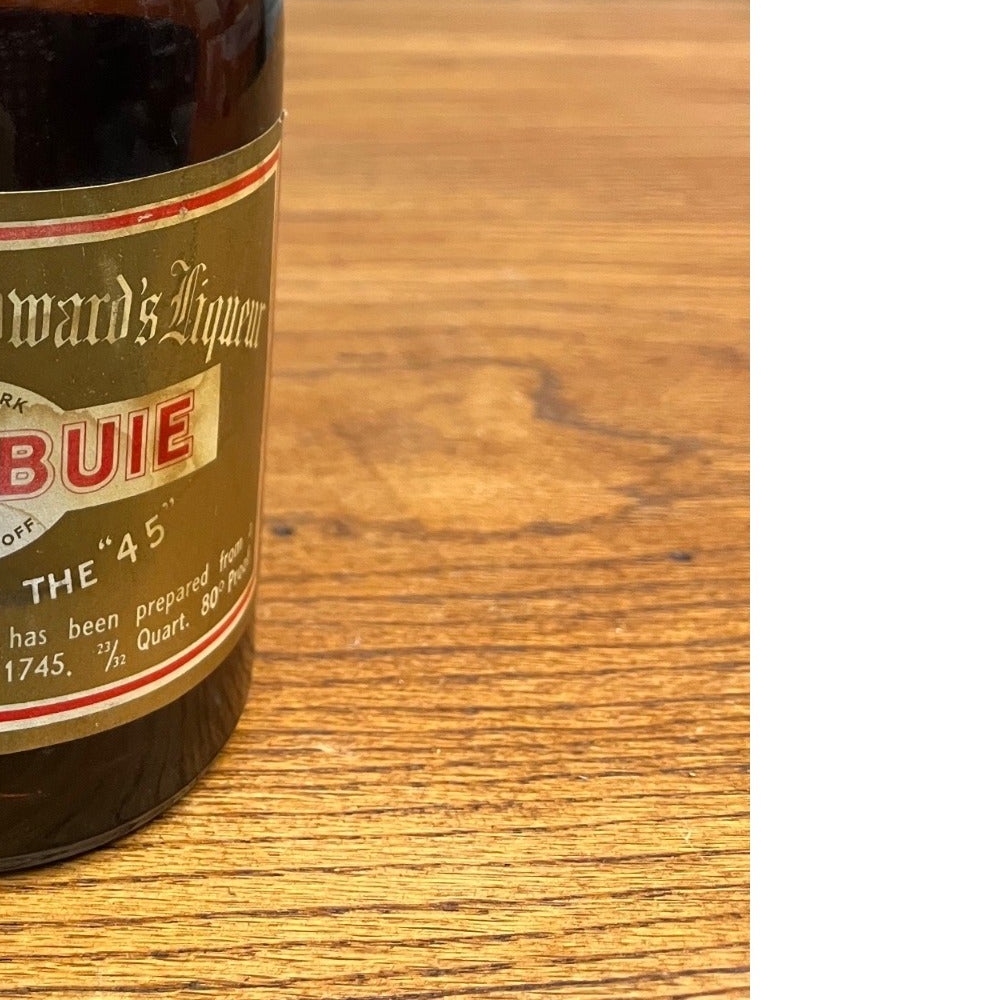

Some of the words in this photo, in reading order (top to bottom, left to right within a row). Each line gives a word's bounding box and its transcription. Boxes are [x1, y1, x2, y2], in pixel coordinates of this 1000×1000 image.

[159, 259, 266, 364] Liqueur
[2, 517, 34, 546] OFF
[10, 626, 47, 649] has
[68, 613, 119, 639] been
[136, 562, 209, 627] prepared
[219, 536, 244, 572] from
[22, 559, 98, 605] THE
[5, 652, 73, 682] 1745.
[137, 612, 190, 651] Quart.
